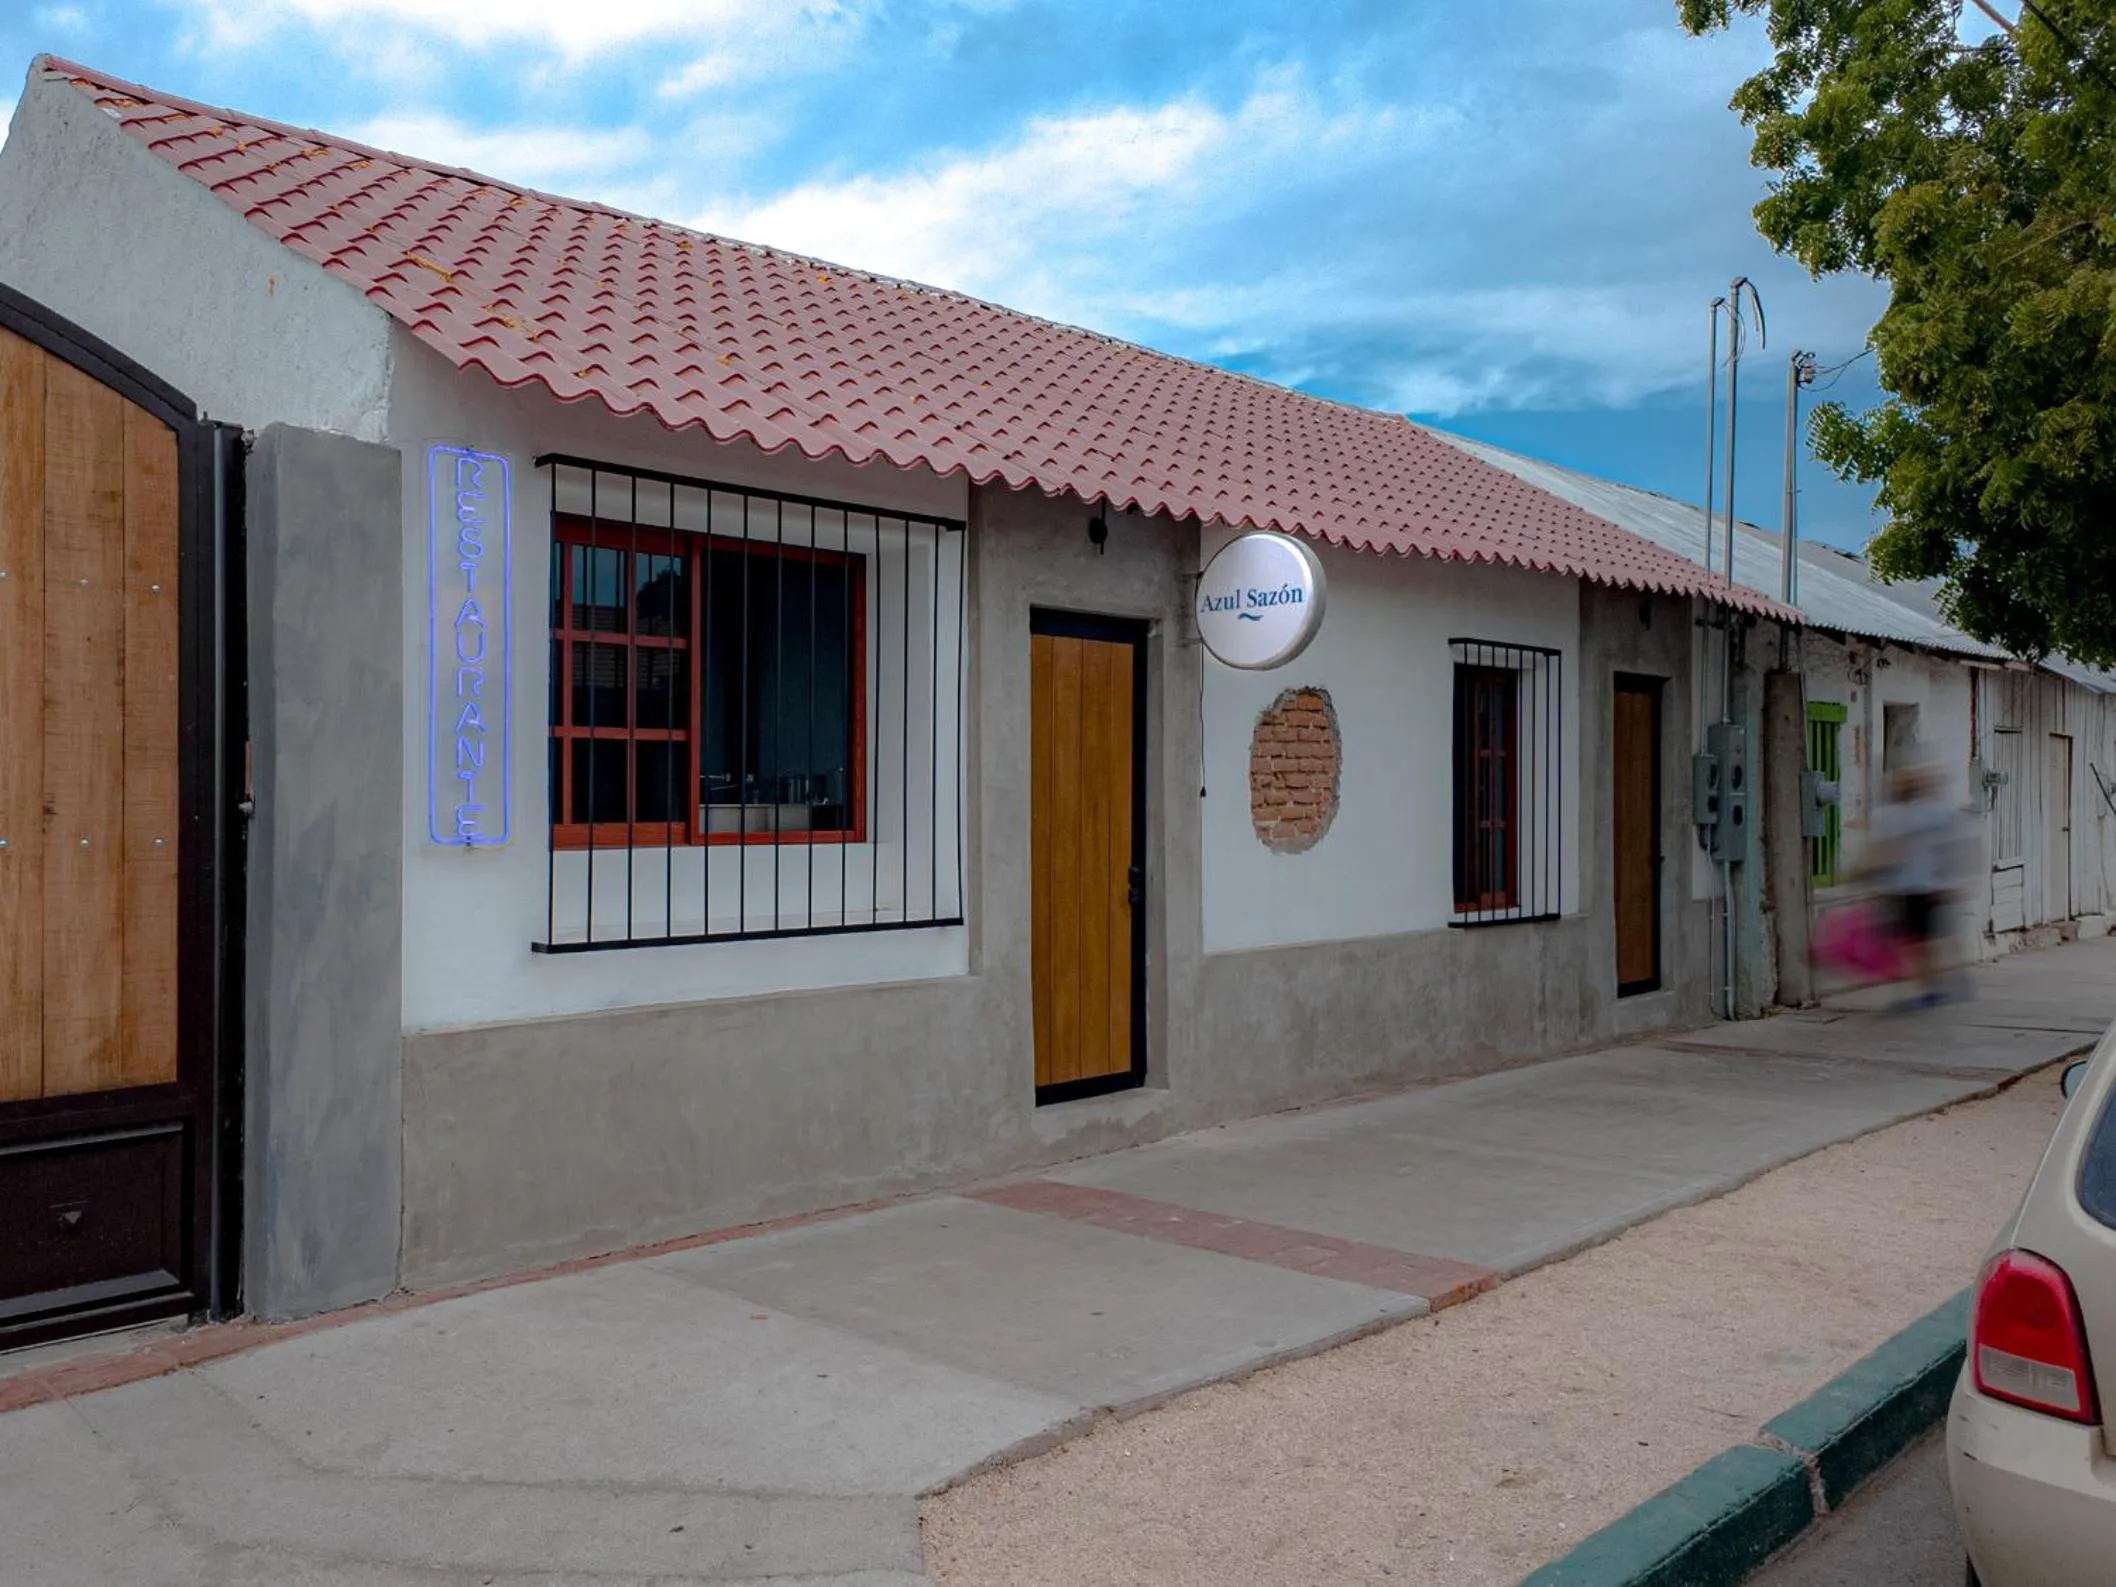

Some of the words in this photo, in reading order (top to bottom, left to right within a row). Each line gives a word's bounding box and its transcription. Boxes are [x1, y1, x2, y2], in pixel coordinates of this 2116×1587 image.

[455, 457, 487, 836] RESTAURANTE
[1201, 589, 1240, 612] Azul
[1247, 583, 1303, 608] Sazón
